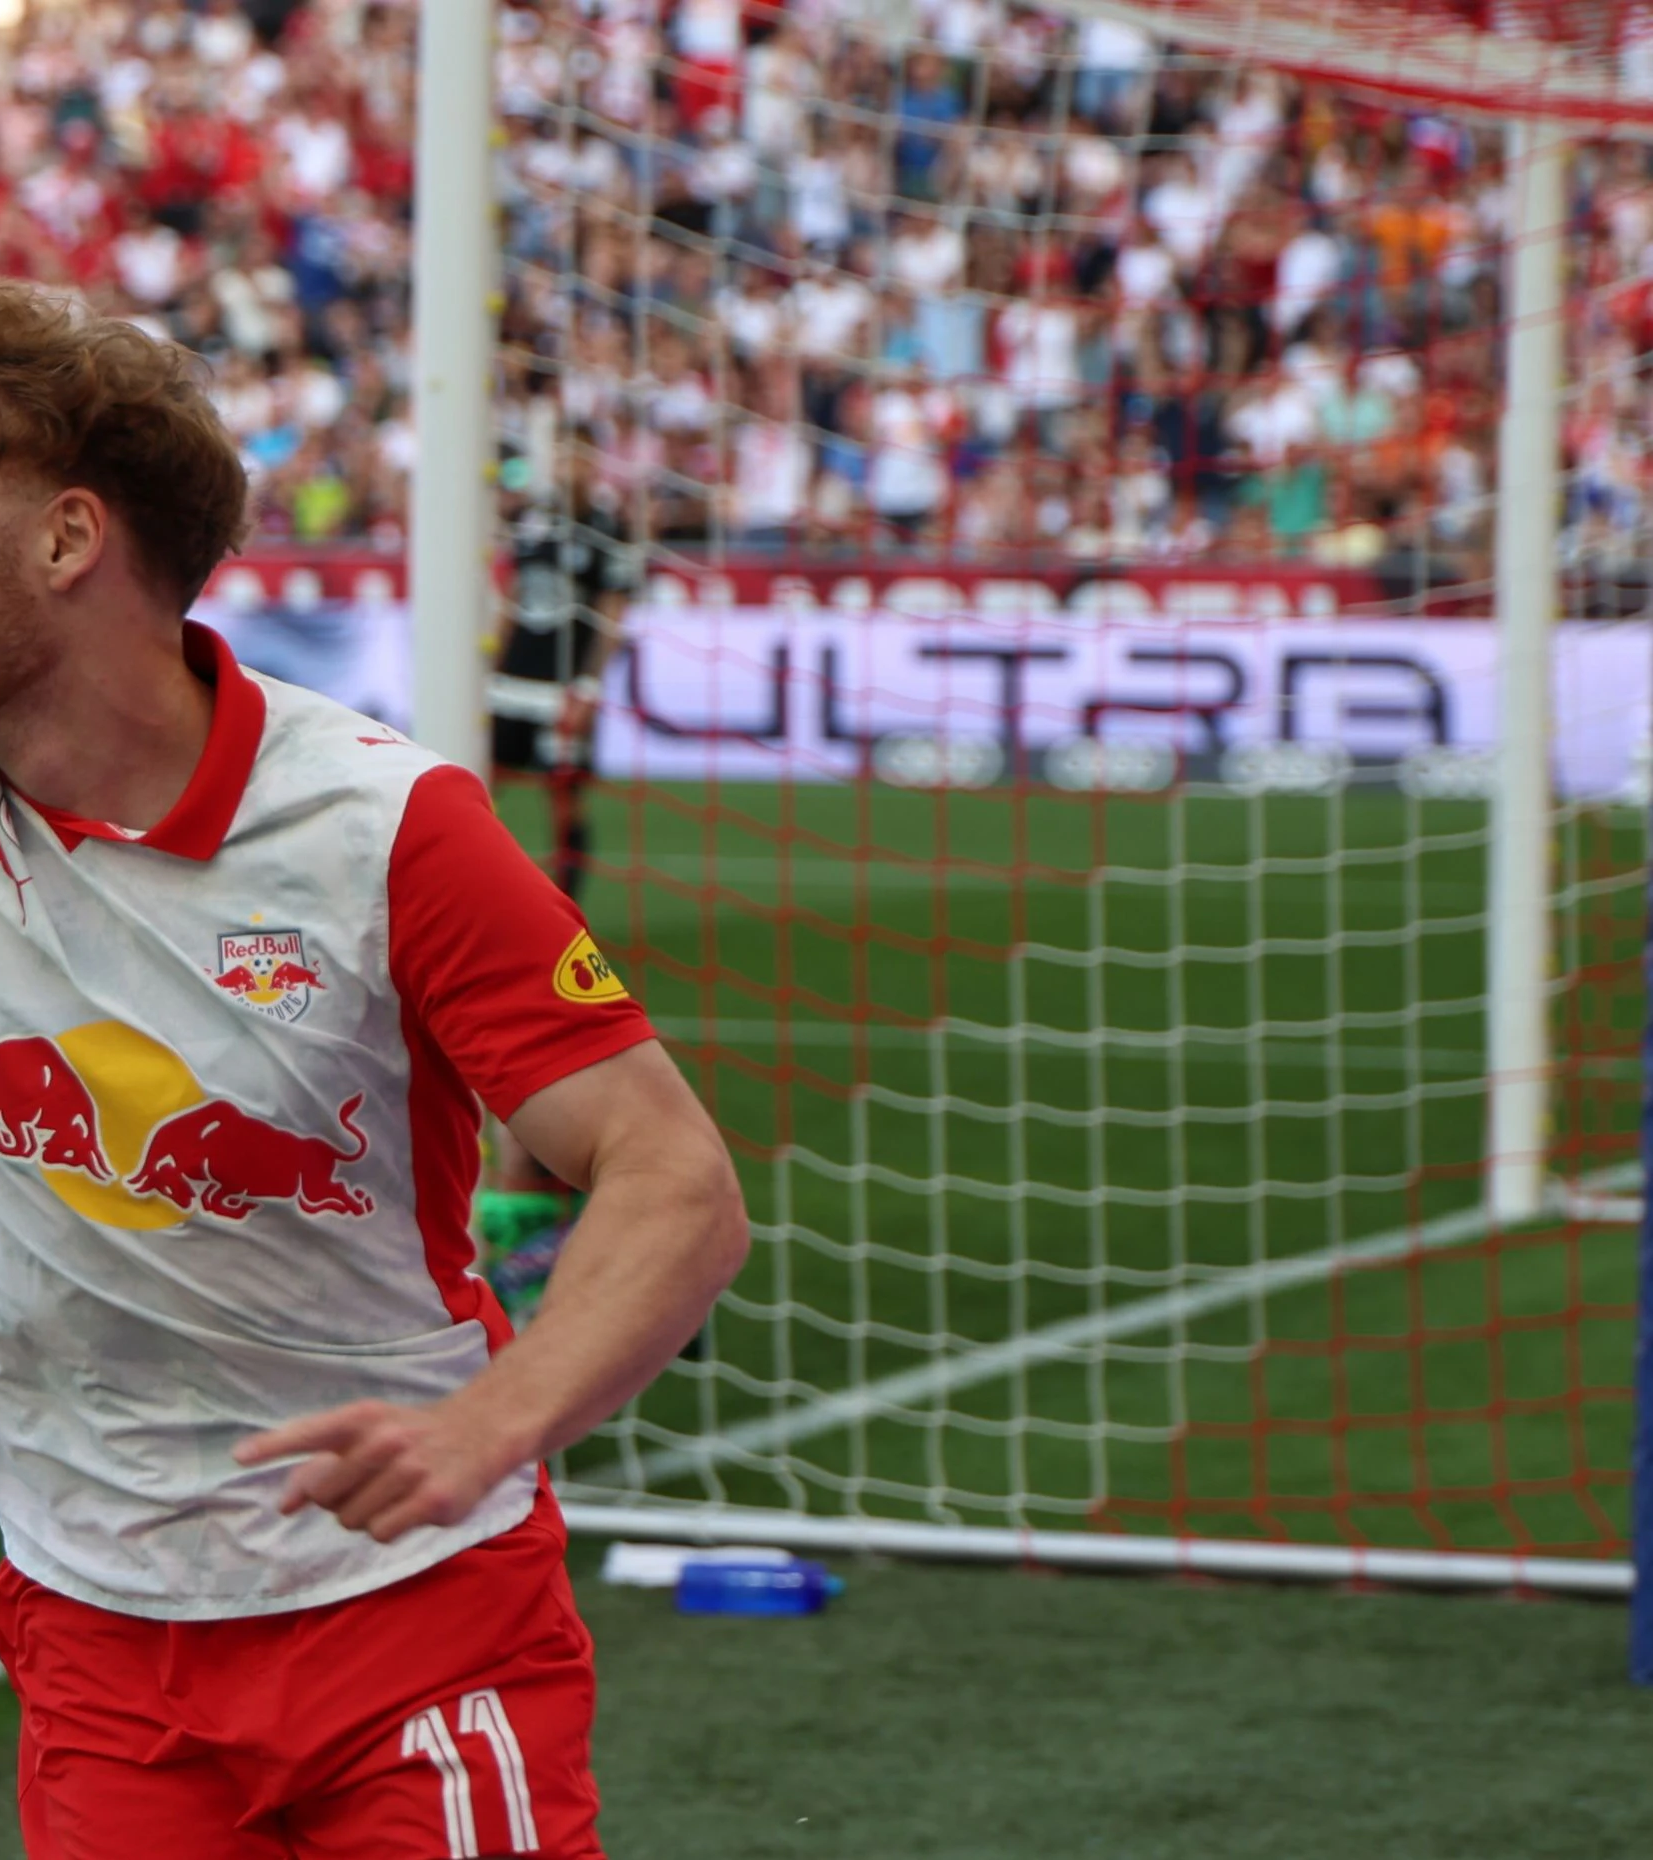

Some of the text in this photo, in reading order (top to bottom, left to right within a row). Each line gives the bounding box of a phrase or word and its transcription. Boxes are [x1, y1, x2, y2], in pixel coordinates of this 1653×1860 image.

[224, 935, 299, 959] Red Bull
[401, 1687, 540, 1860] 11
